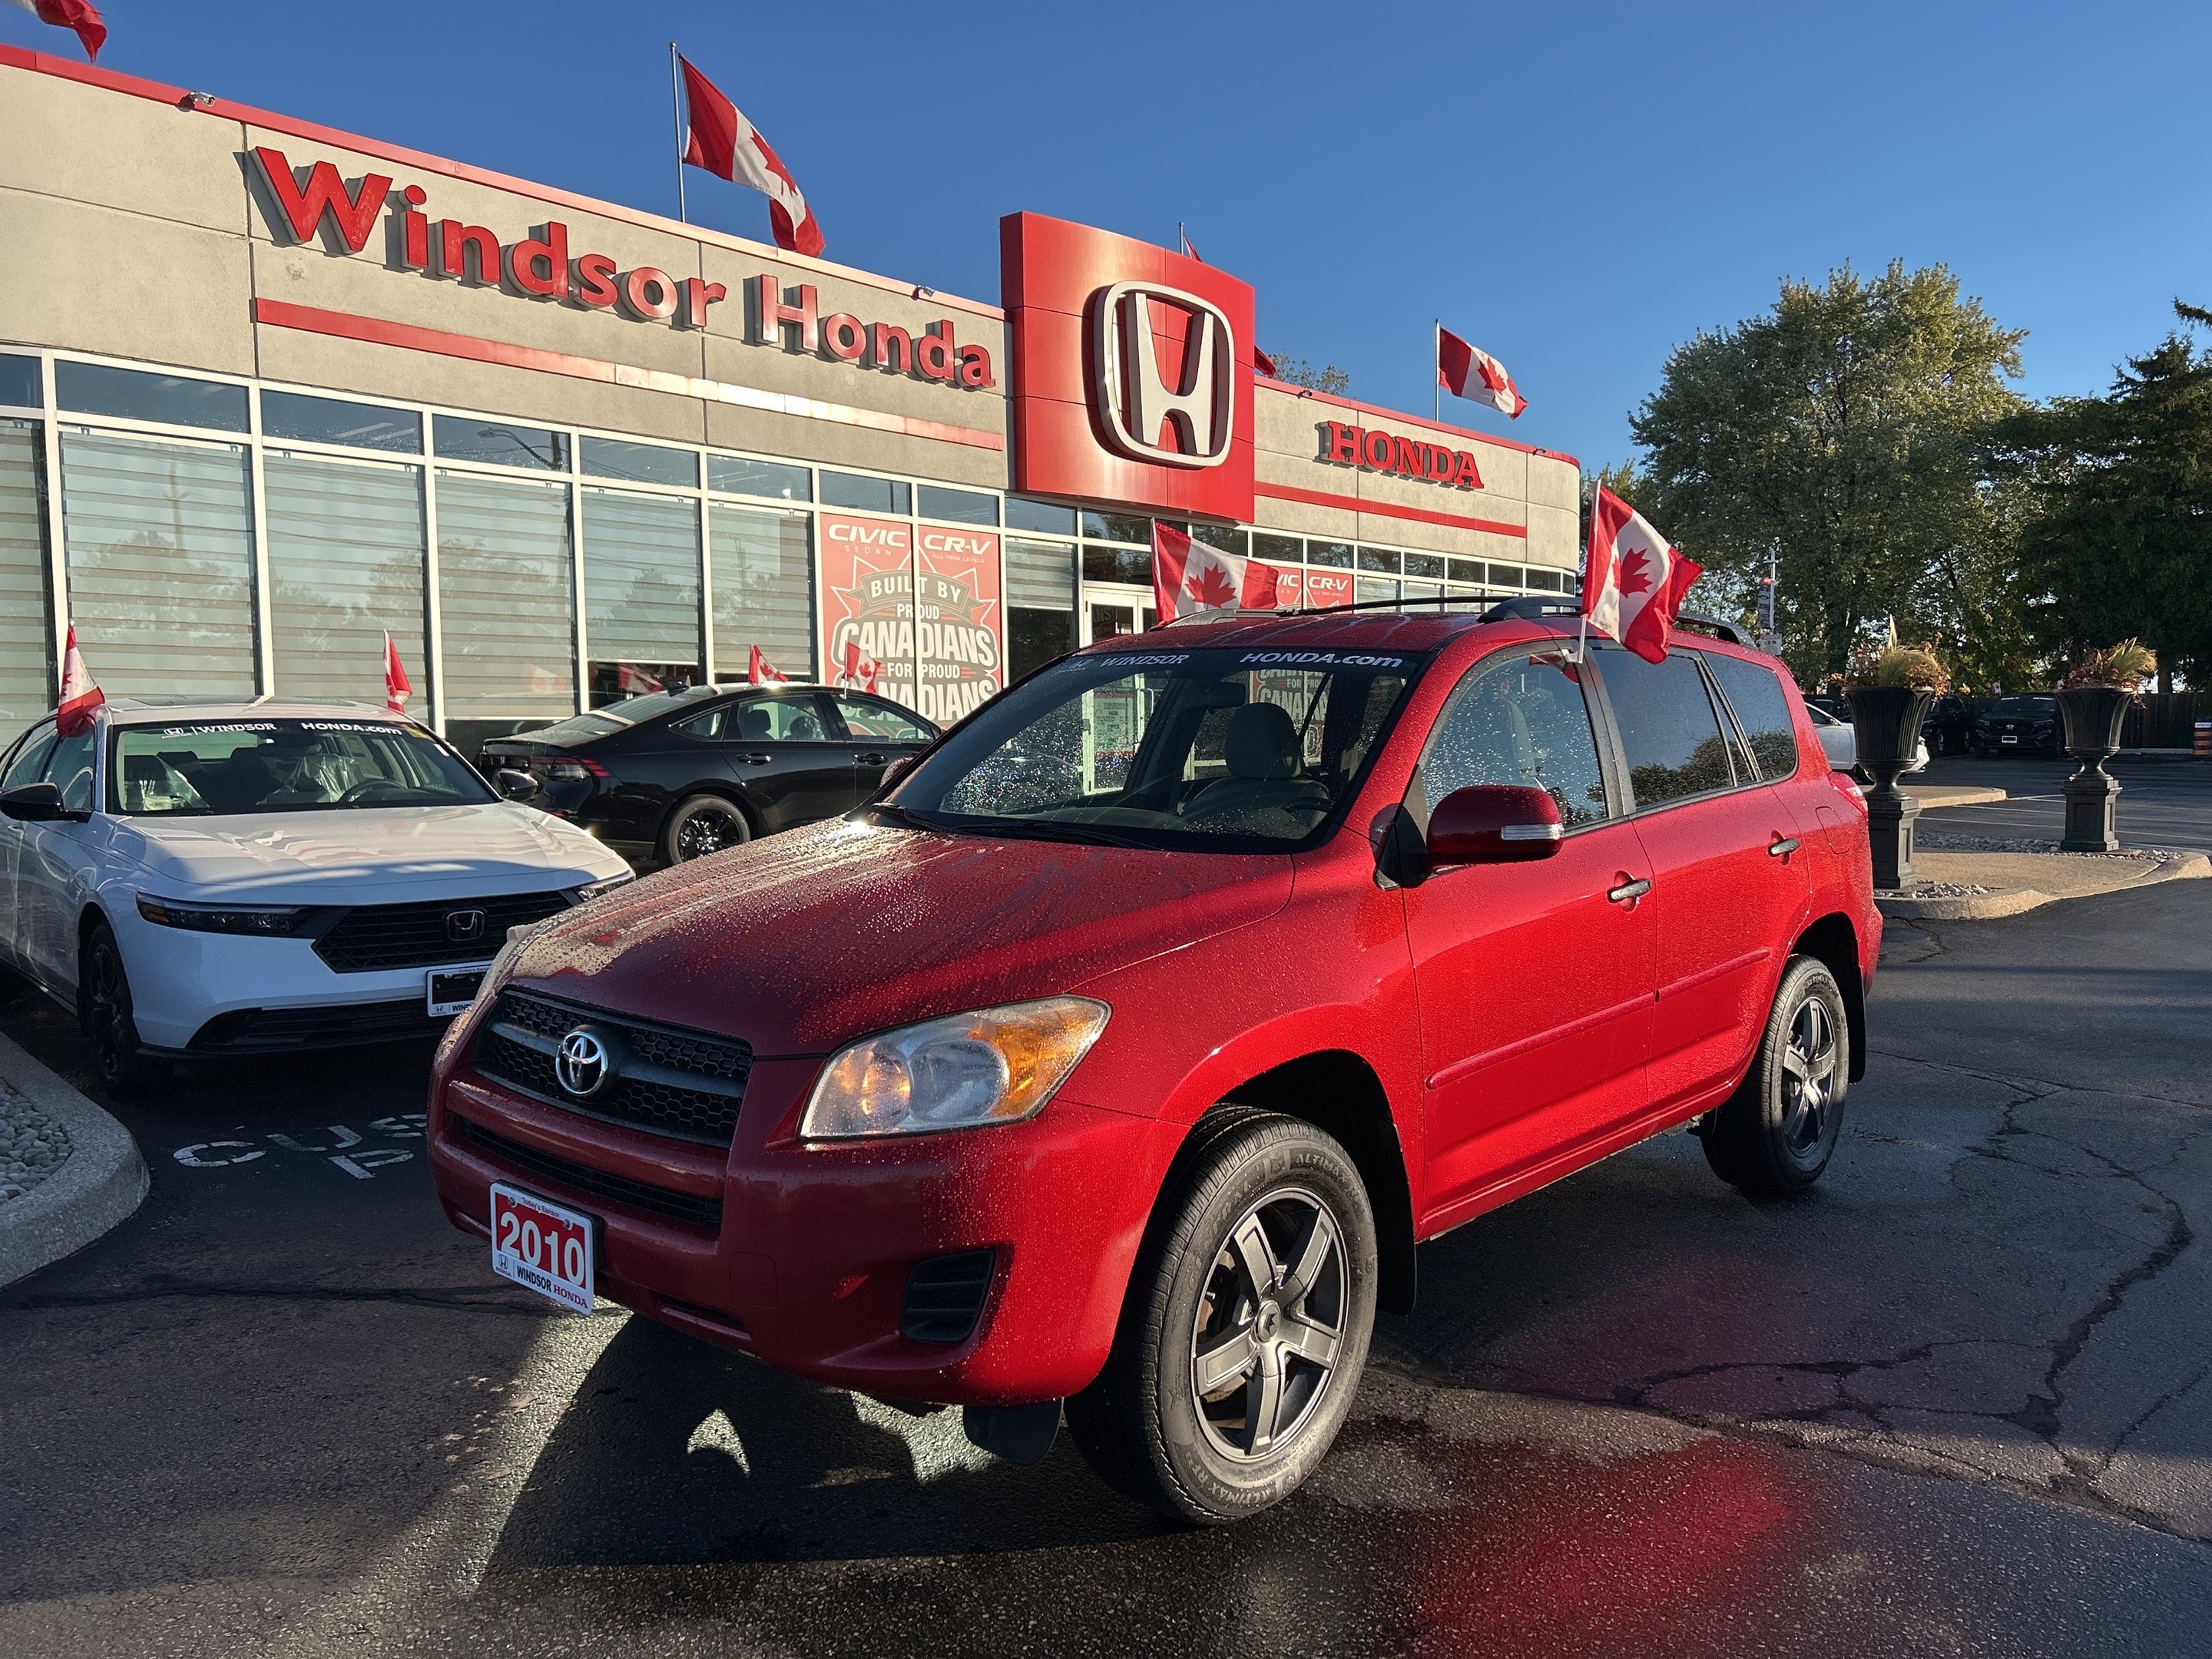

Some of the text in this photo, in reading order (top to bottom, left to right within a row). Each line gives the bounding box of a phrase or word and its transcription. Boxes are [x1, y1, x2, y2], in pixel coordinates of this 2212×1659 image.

[253, 145, 996, 389] Windsor Honda
[1324, 419, 1485, 490] HONDA
[828, 524, 907, 548] CIVIC
[923, 534, 992, 555] CR-V
[845, 545, 892, 557] SEDAN
[870, 576, 962, 604] BUILT BY
[1308, 575, 1349, 591] CR-V
[839, 621, 994, 667] CANADIANS
[887, 662, 960, 679] FOR PROUD
[1100, 654, 1190, 667] WINDSOR
[1239, 652, 1404, 670] HONDA.com
[1286, 679, 1302, 688] FOR
[197, 722, 403, 736] WINDSOR HONDA.com
[500, 1211, 584, 1287] 2010
[516, 1265, 588, 1309] WINDSOR HONDA
